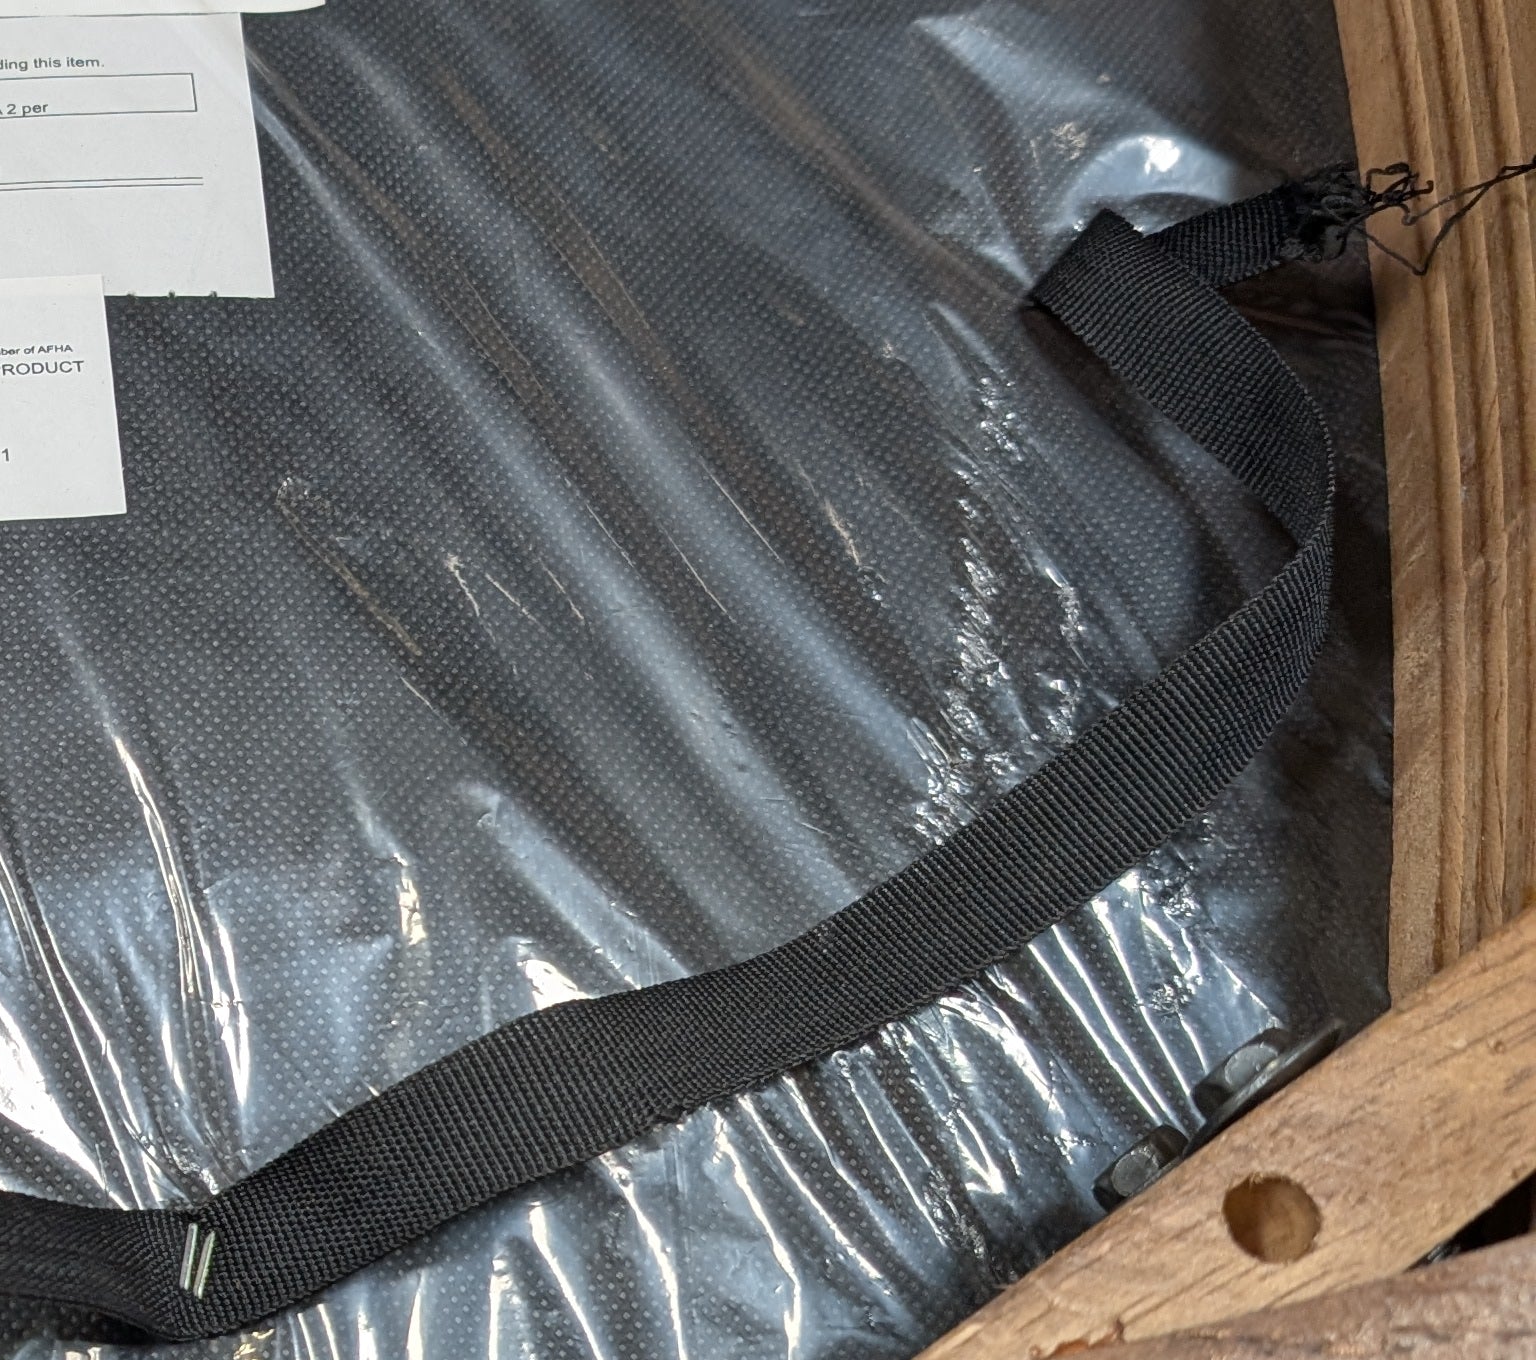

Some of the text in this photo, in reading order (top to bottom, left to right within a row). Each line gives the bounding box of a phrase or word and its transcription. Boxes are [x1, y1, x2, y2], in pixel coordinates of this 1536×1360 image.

[34, 58, 61, 68] this
[67, 57, 104, 67] item.
[7, 104, 16, 115] 2
[18, 104, 51, 118] per
[24, 346, 35, 354] of
[38, 345, 73, 354] AFHA
